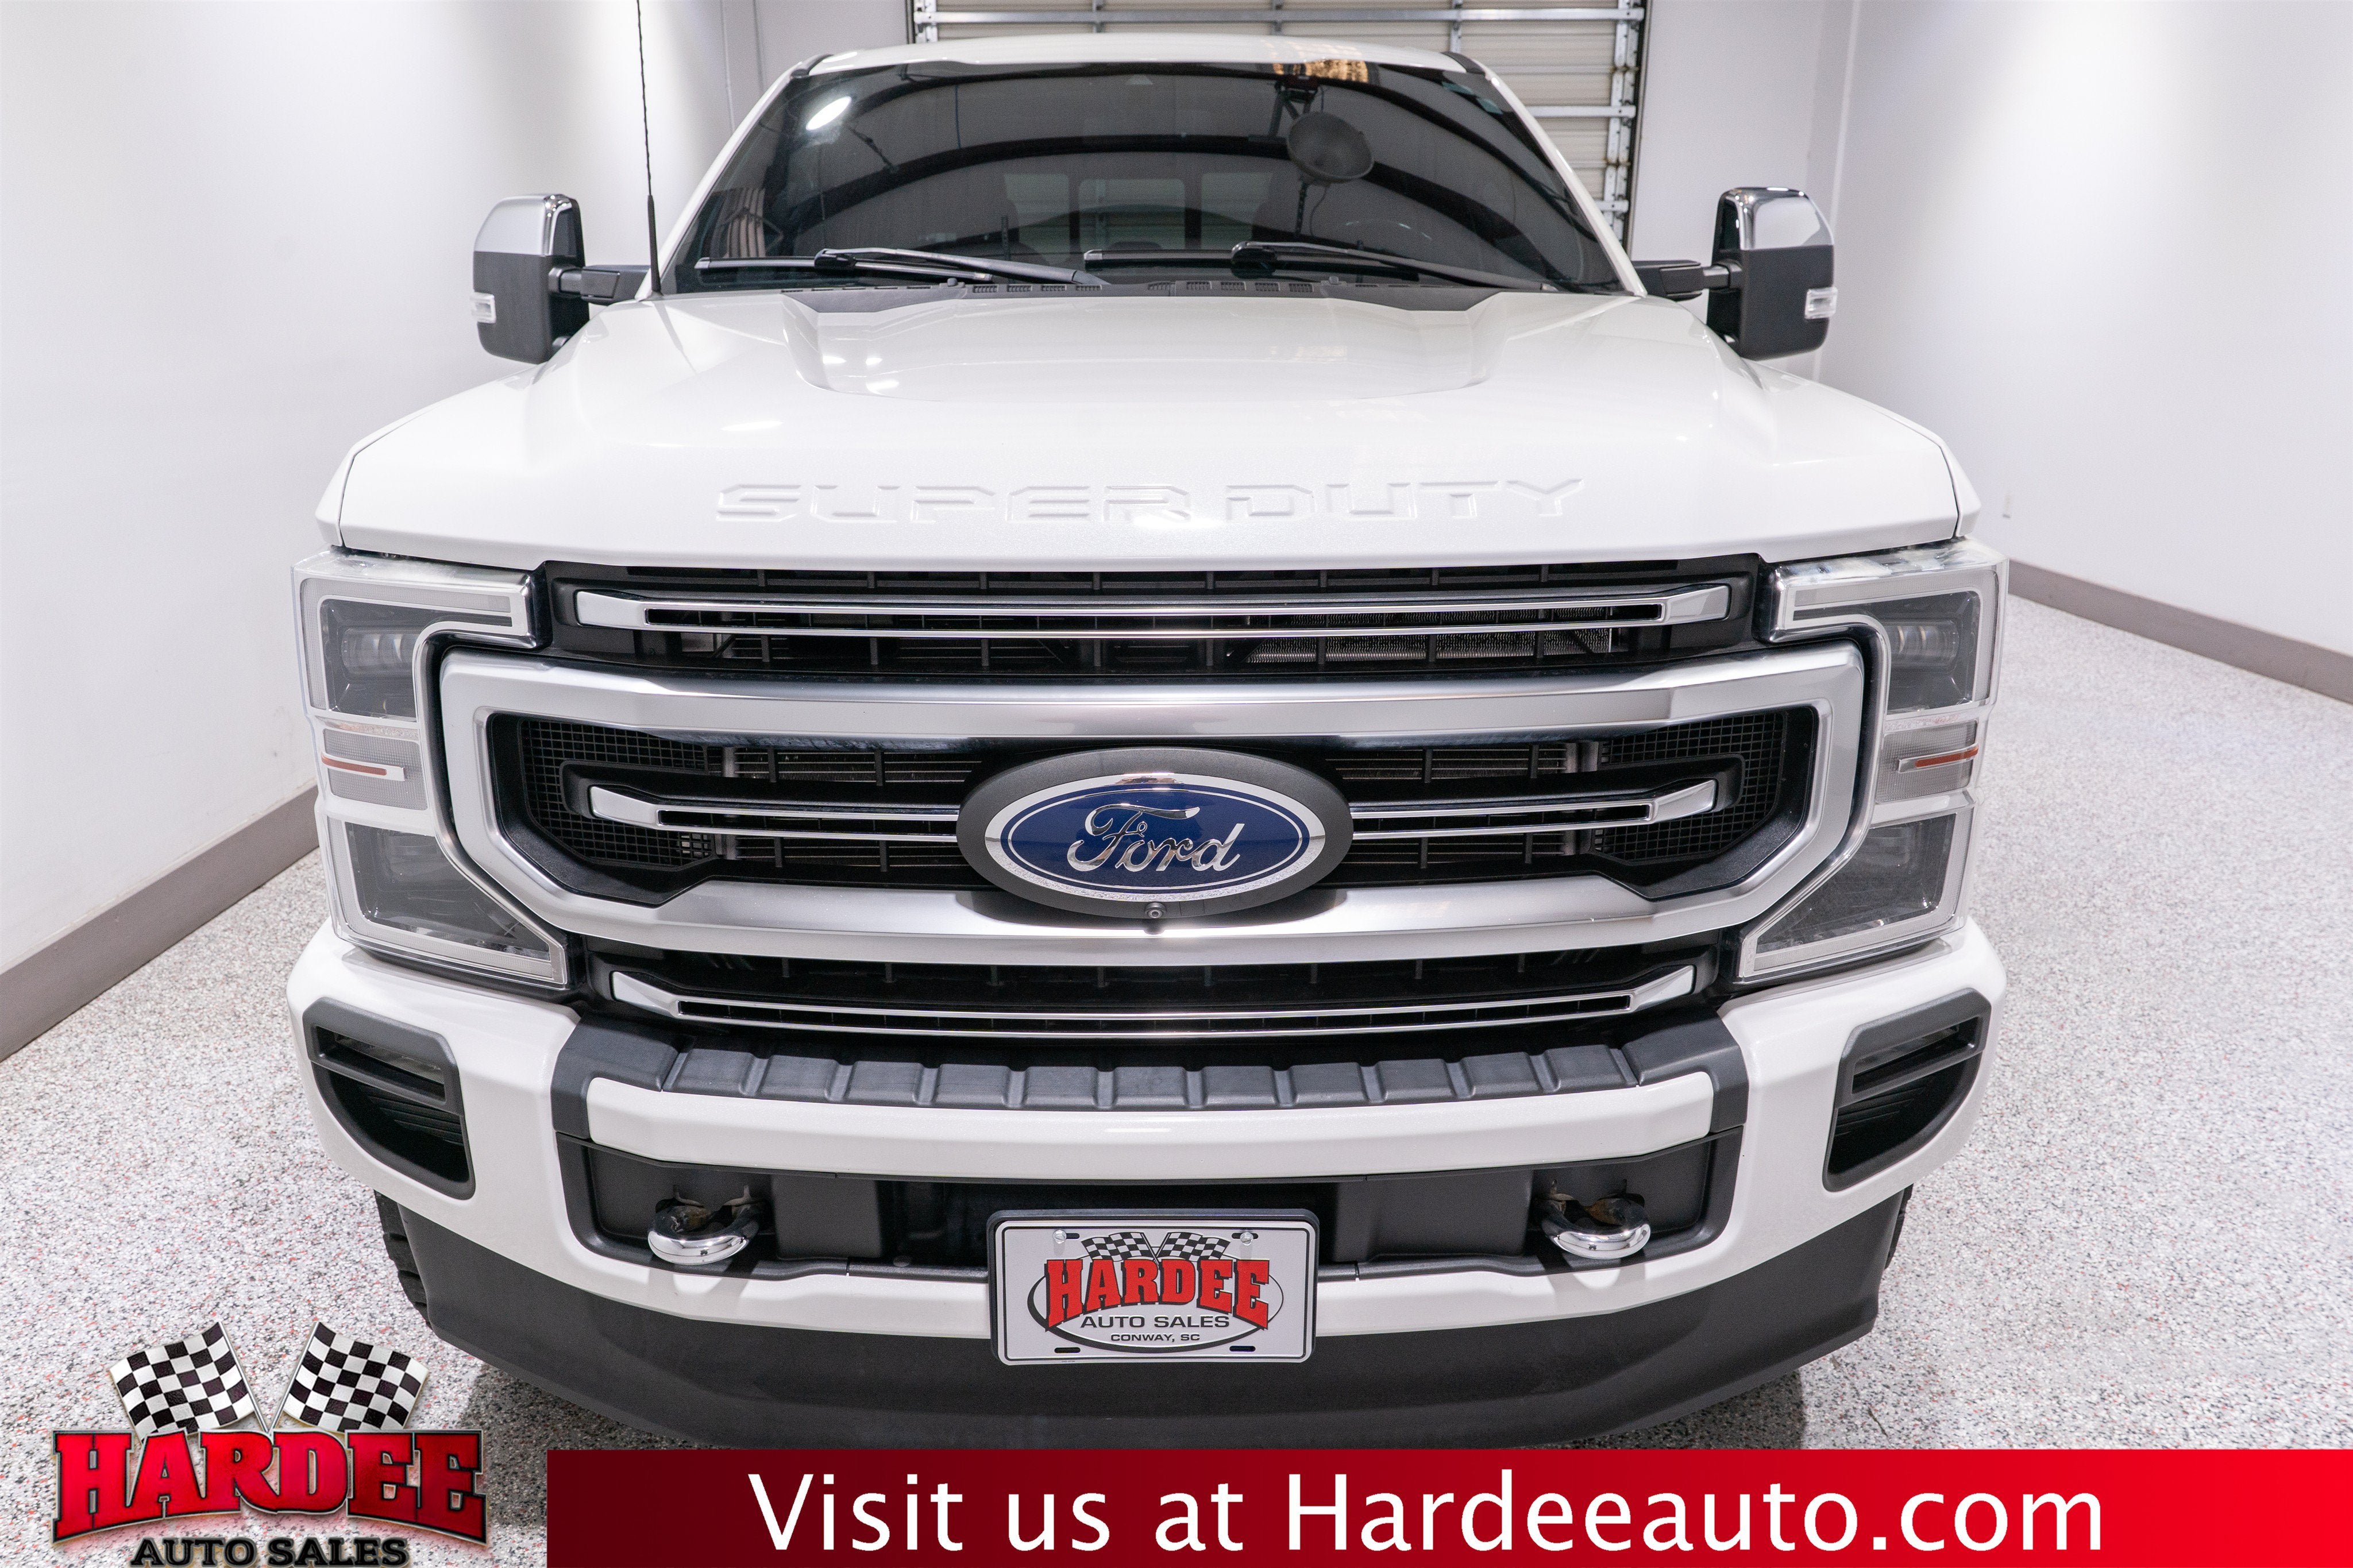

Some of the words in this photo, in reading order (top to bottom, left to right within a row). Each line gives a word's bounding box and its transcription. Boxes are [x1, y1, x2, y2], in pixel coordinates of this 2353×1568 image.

[716, 482, 1194, 525] SUPER
[1224, 478, 1587, 522] DUTY
[1067, 804, 1245, 872] Ford
[1044, 1259, 1270, 1331] HARDEE
[1080, 1316, 1145, 1328] AUTO
[1153, 1315, 1230, 1328] SALES
[1110, 1334, 1175, 1343] CONWAY,
[1180, 1334, 1201, 1342] SC
